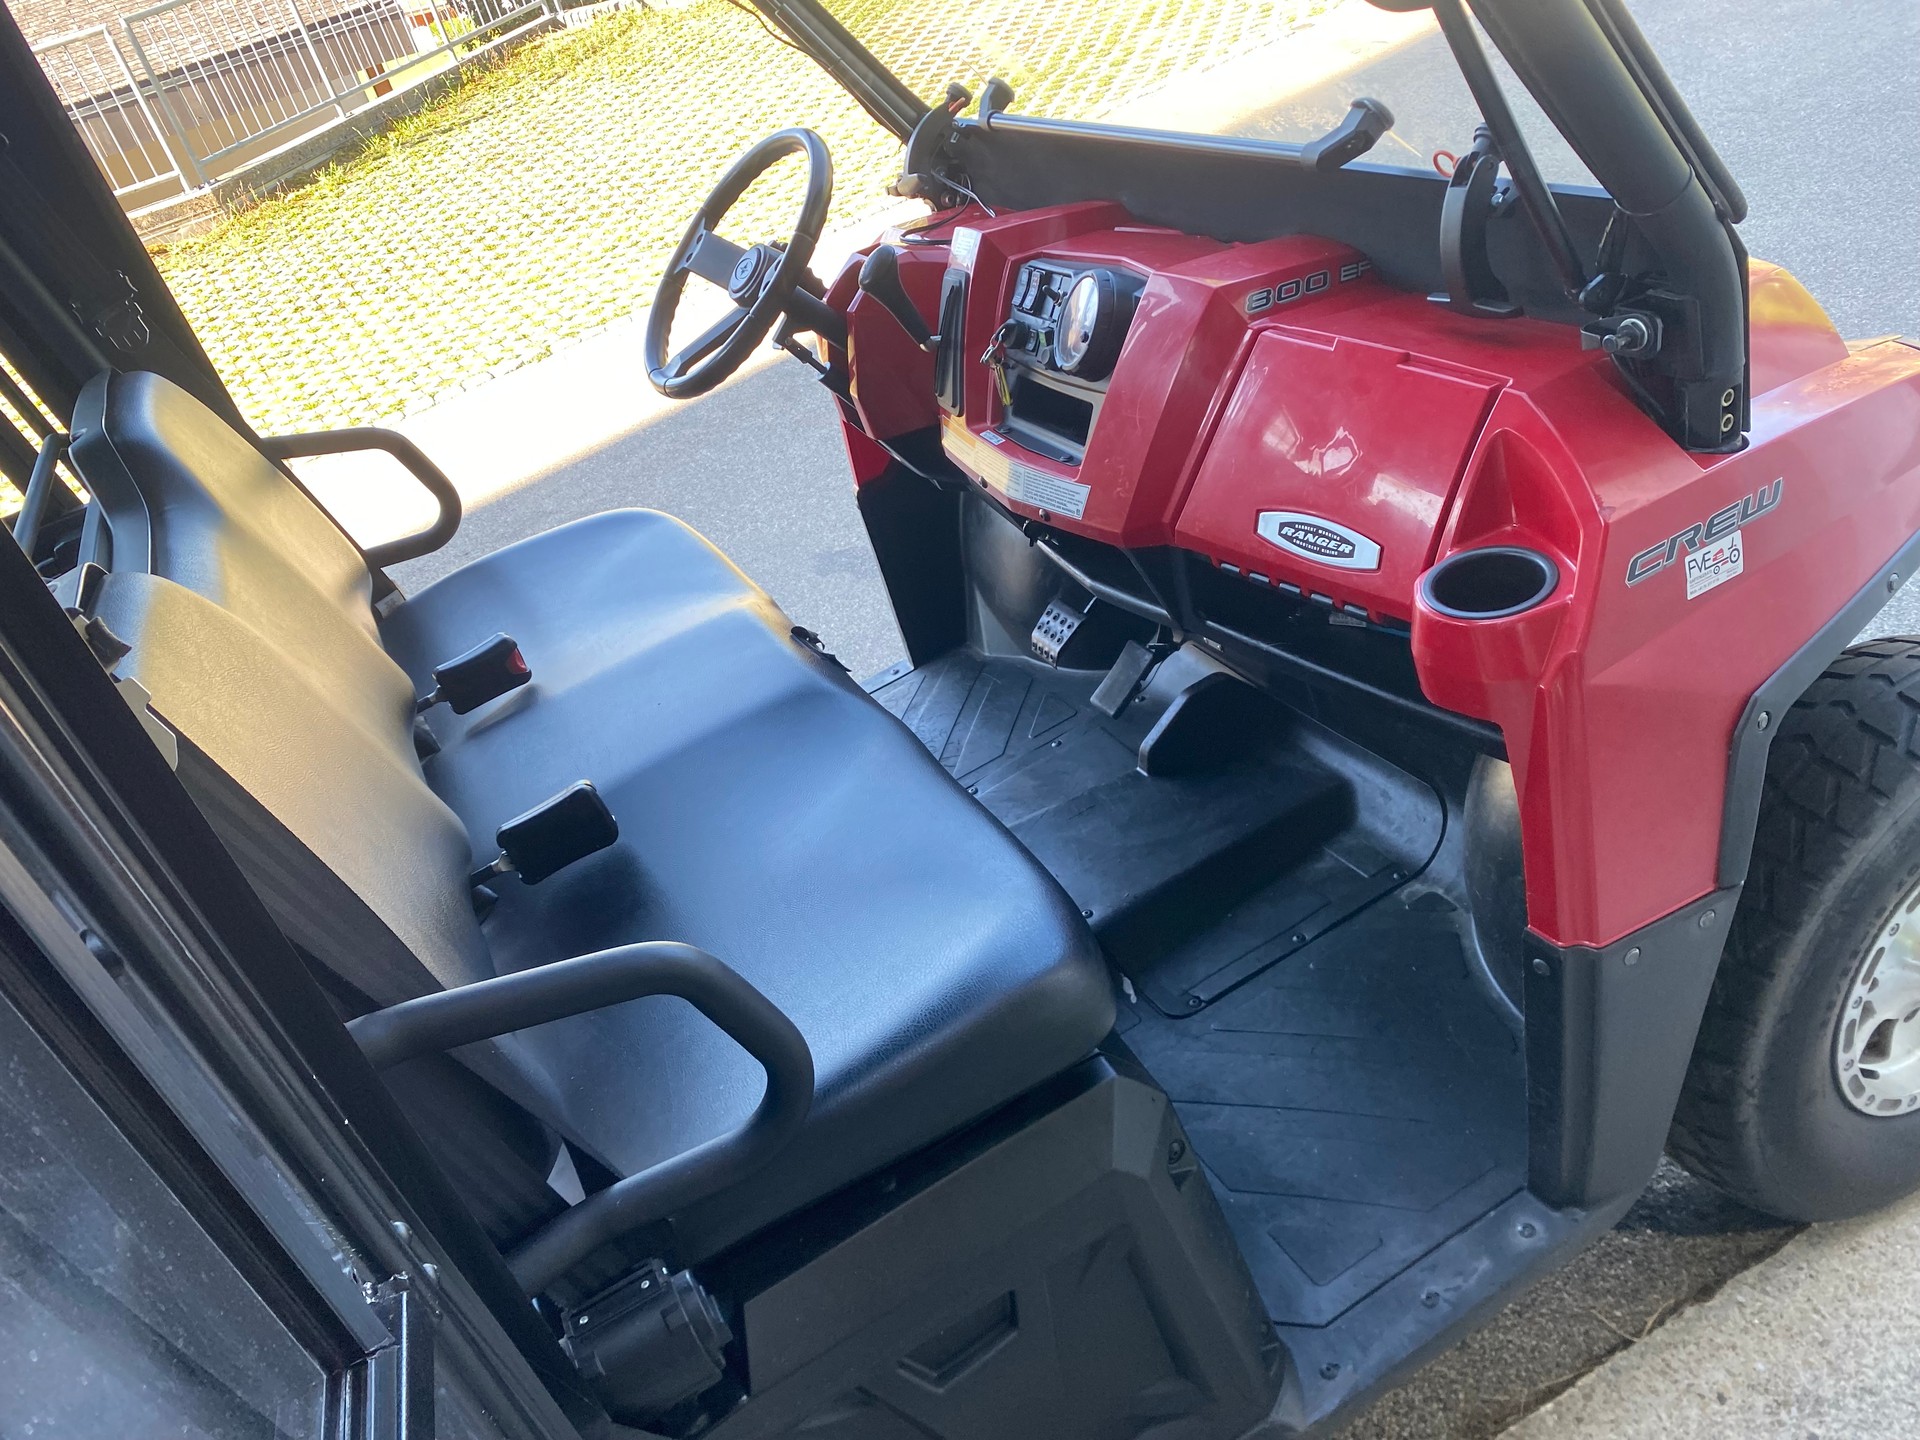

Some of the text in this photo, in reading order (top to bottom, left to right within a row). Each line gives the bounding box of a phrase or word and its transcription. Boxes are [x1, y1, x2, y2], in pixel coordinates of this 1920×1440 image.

[1245, 270, 1330, 314] 800
[1280, 526, 1353, 554] RANGER
[1625, 477, 1783, 588] CREW
[1688, 550, 1712, 579] FVE
